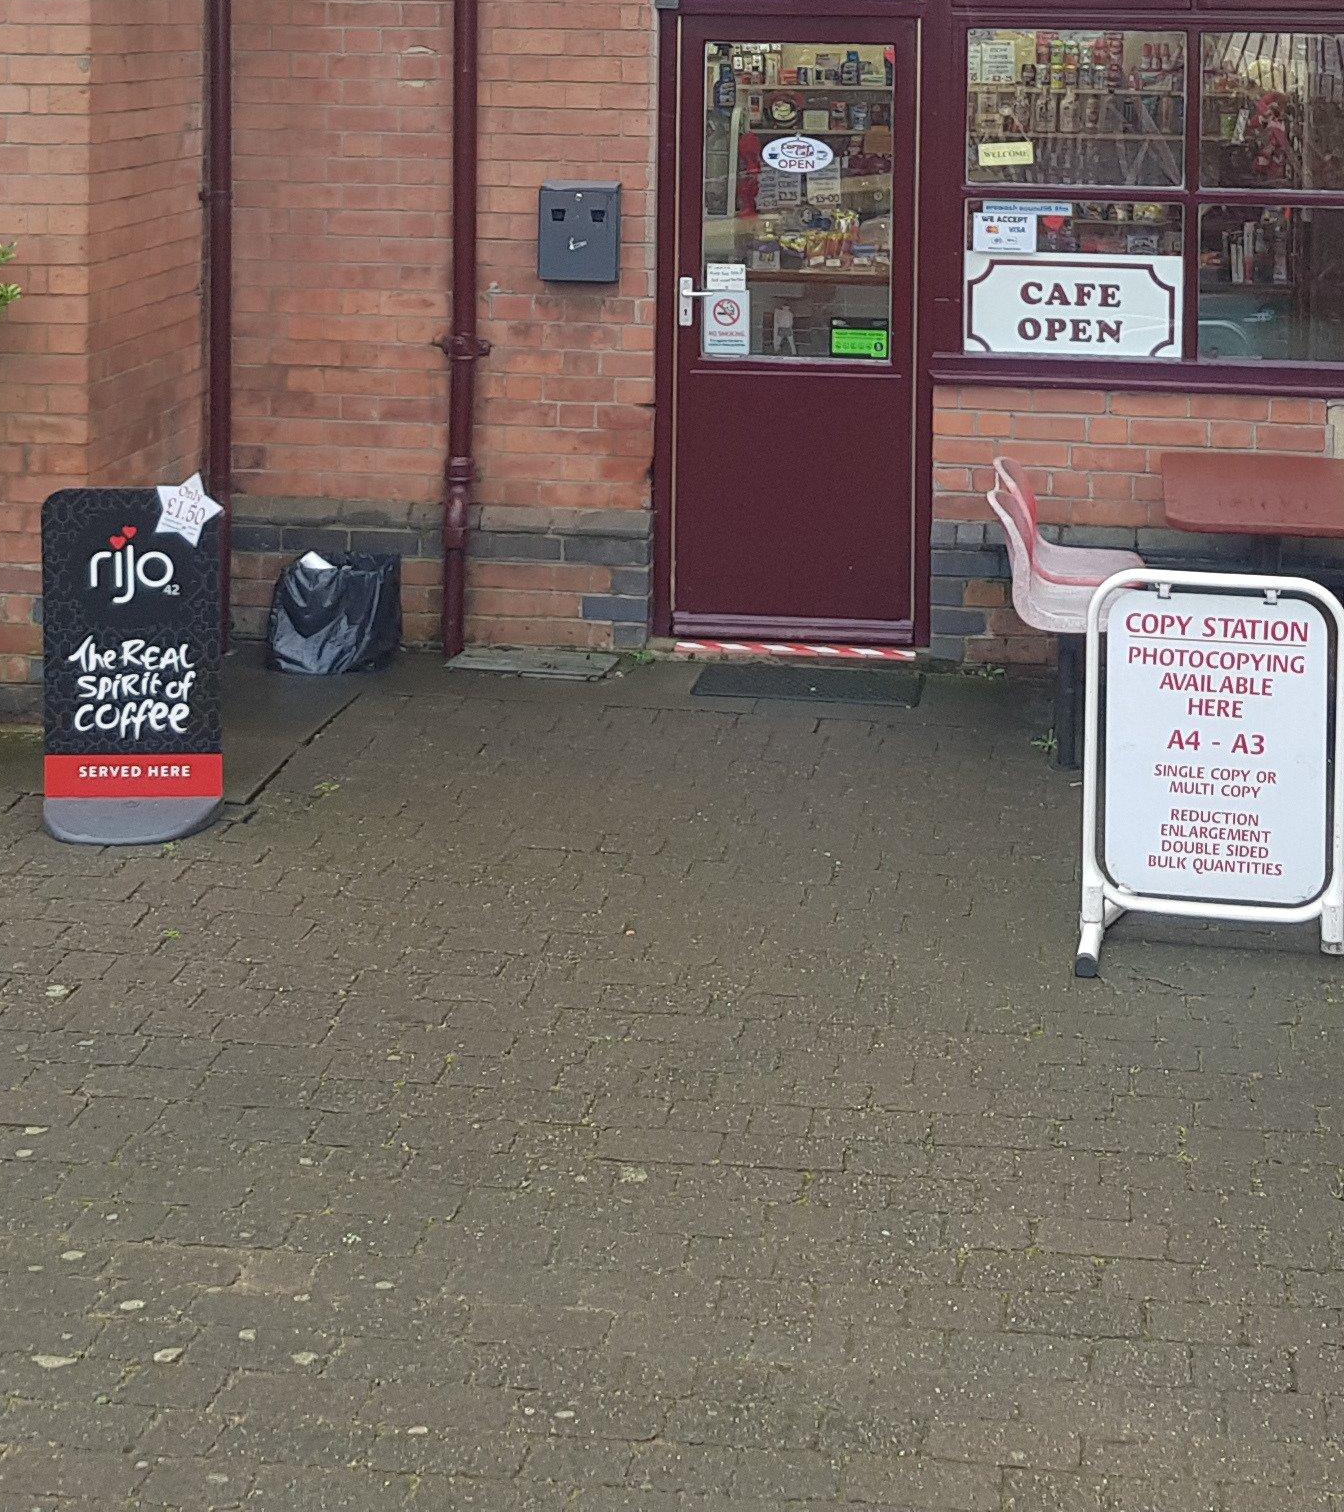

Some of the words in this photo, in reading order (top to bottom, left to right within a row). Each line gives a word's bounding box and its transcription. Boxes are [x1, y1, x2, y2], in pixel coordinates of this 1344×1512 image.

[778, 159, 815, 168] OPEN
[983, 150, 1029, 158] WELCOME
[1019, 281, 1123, 309] CAFE
[1016, 318, 1124, 344] OPEN
[177, 485, 203, 504] Only
[166, 496, 206, 526] £1.50
[1125, 612, 1193, 638] COPY
[1202, 616, 1309, 643] STATION
[69, 635, 117, 673] The
[121, 638, 195, 671] REAL
[1127, 646, 1306, 675] PHOTOCOPYING
[166, 670, 197, 703] of
[1159, 673, 1274, 697] AVAILABLE
[1187, 697, 1244, 719] HERE
[1166, 729, 1201, 752] A4
[1230, 732, 1266, 756] A3
[78, 764, 143, 779] SERVED
[147, 764, 192, 778] HERE
[1154, 763, 1204, 780] SINGLE
[1210, 767, 1252, 784] COPY
[1256, 769, 1277, 785] OR
[1169, 779, 1217, 797] MULTI
[1220, 783, 1262, 800] COPY
[1170, 808, 1260, 828] REDUCTION
[1160, 825, 1272, 844] ENLARGEMENT
[1161, 839, 1221, 856] DOUBLE
[1226, 843, 1270, 859] SIDED
[1147, 854, 1187, 871] BULK
[1192, 857, 1284, 877] QUANTITIES
